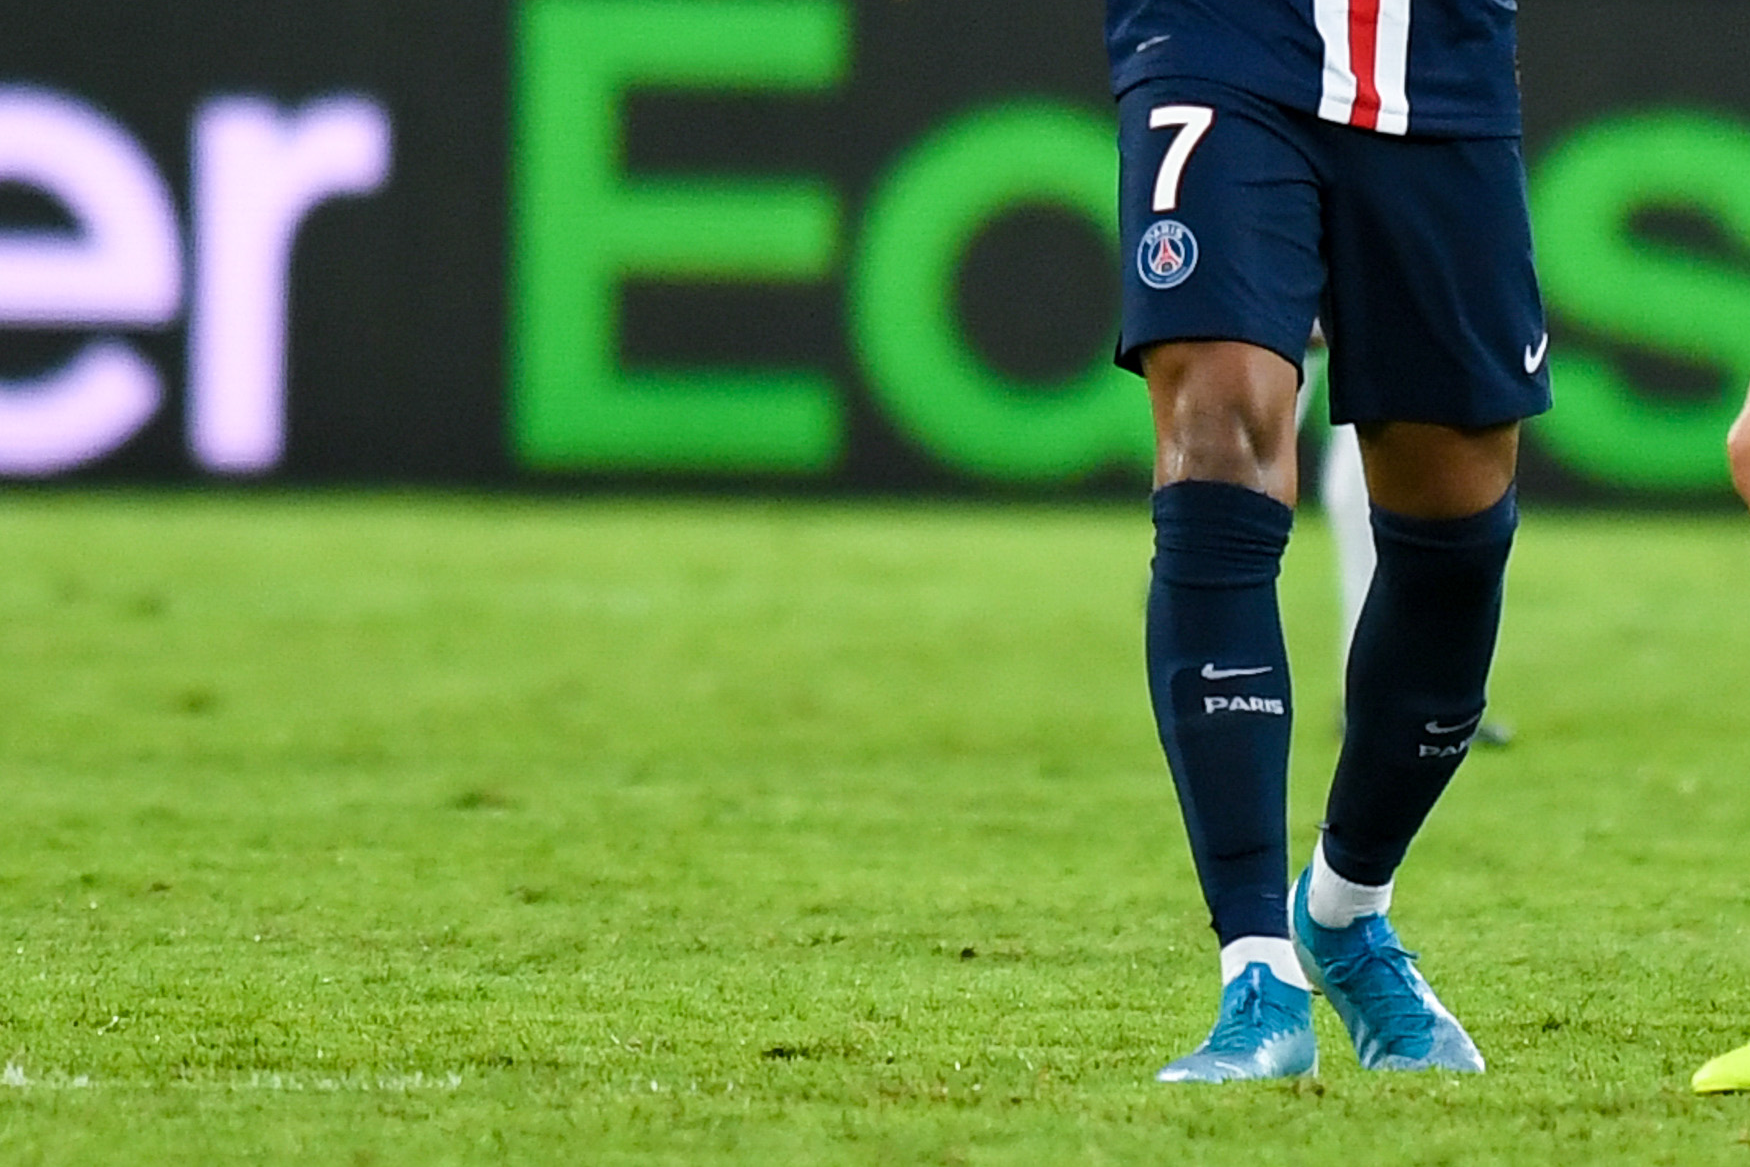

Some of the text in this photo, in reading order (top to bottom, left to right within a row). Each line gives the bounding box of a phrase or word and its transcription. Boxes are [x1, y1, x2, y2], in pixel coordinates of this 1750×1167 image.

[1149, 104, 1215, 214] 7
[0, 84, 392, 479] er
[1203, 695, 1285, 715] PARIS
